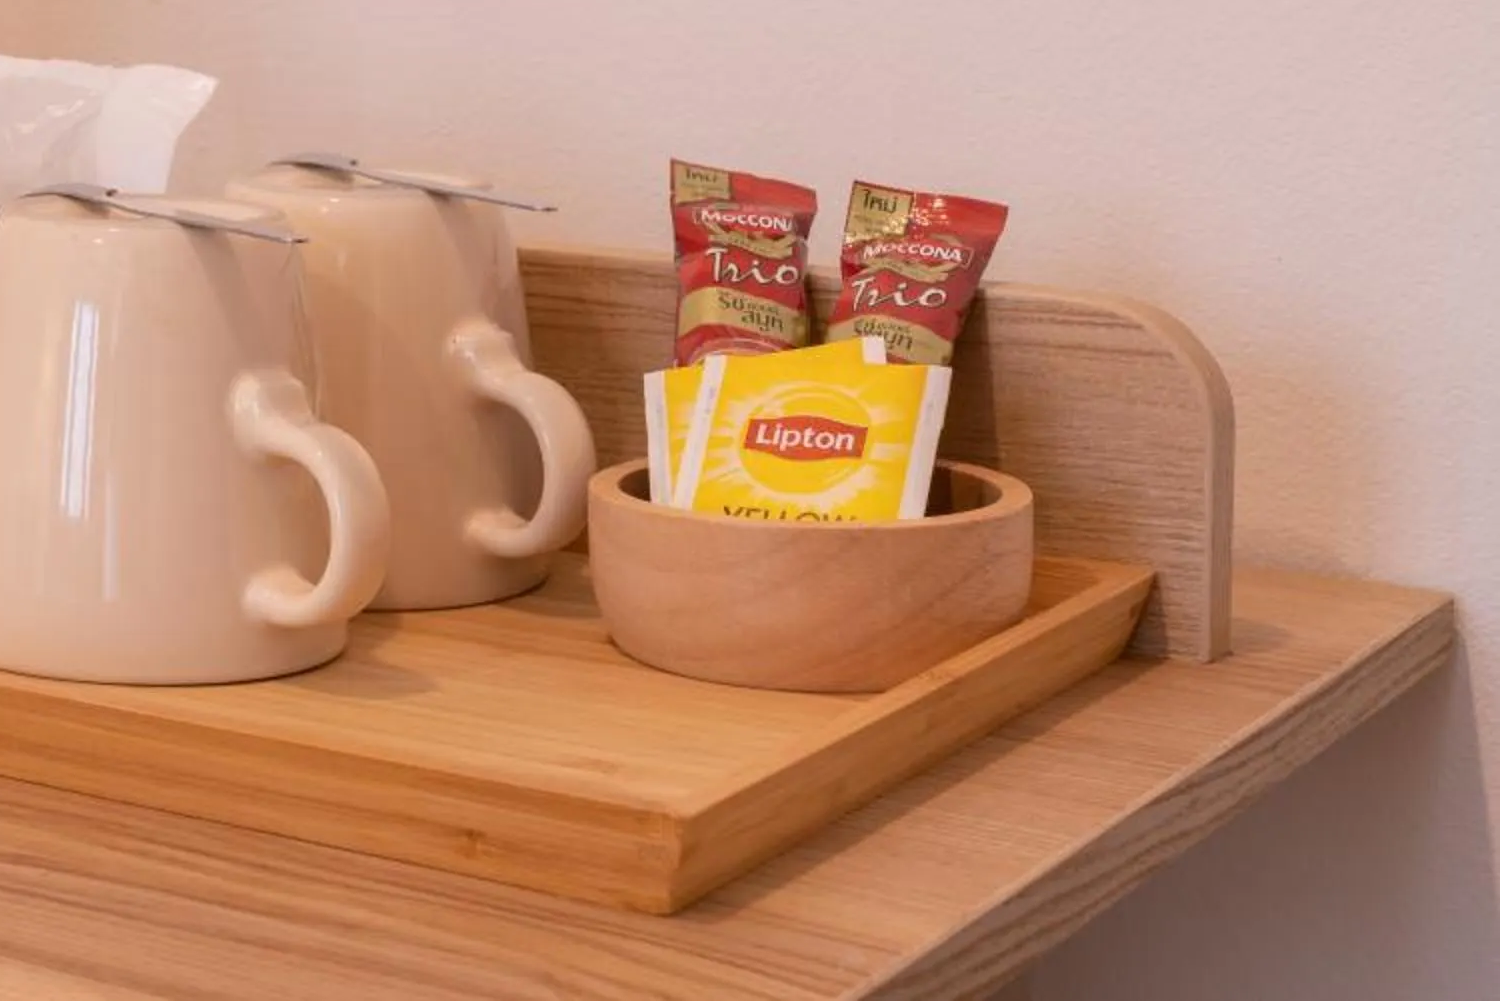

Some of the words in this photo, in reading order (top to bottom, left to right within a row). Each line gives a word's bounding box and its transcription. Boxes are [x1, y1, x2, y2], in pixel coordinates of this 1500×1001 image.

[706, 247, 799, 284] Trio
[852, 277, 948, 312] Trio
[756, 423, 854, 451] Lipton
